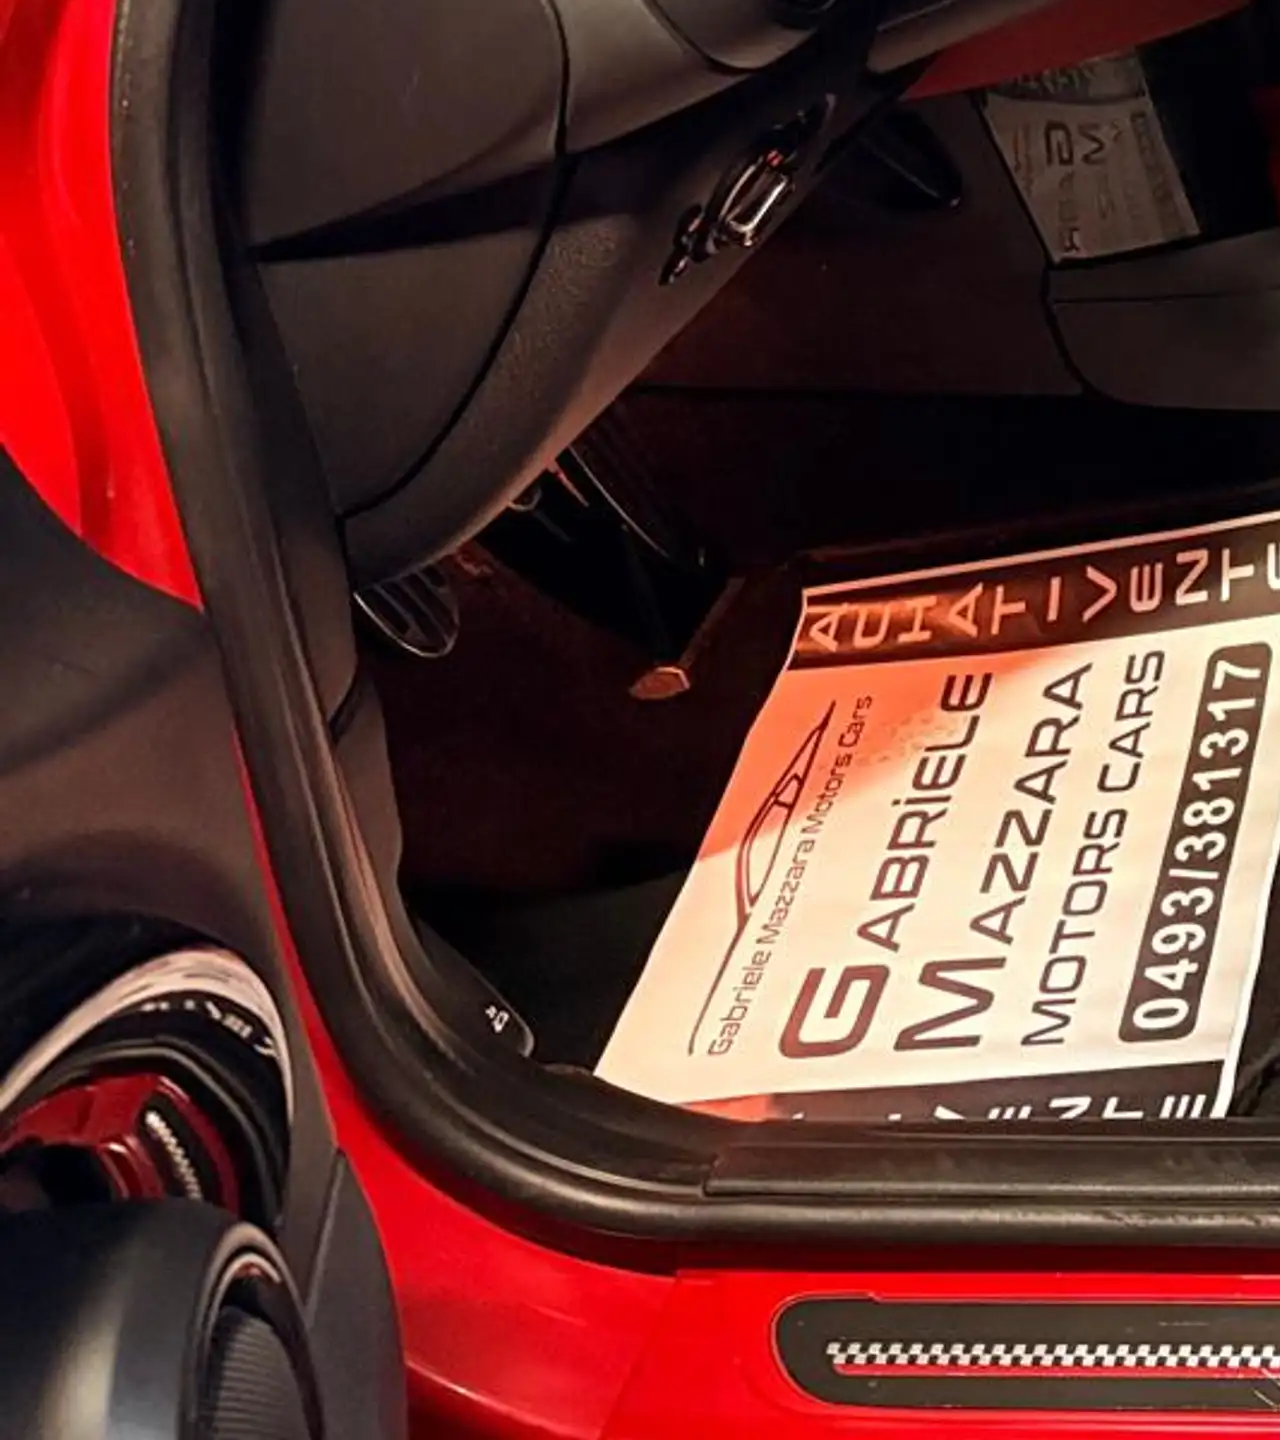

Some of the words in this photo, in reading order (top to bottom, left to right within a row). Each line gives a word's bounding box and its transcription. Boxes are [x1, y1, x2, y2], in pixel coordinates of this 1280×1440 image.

[707, 950, 772, 1057] Gabriele
[756, 839, 816, 946] Mazzara
[806, 752, 853, 837] Motors
[838, 694, 873, 748] Cars
[893, 662, 1093, 1052] MAZZARA
[1020, 809, 1128, 1047] MOTORS
[1098, 650, 1166, 793] CARS
[1132, 660, 1263, 1031] 0493/381317
